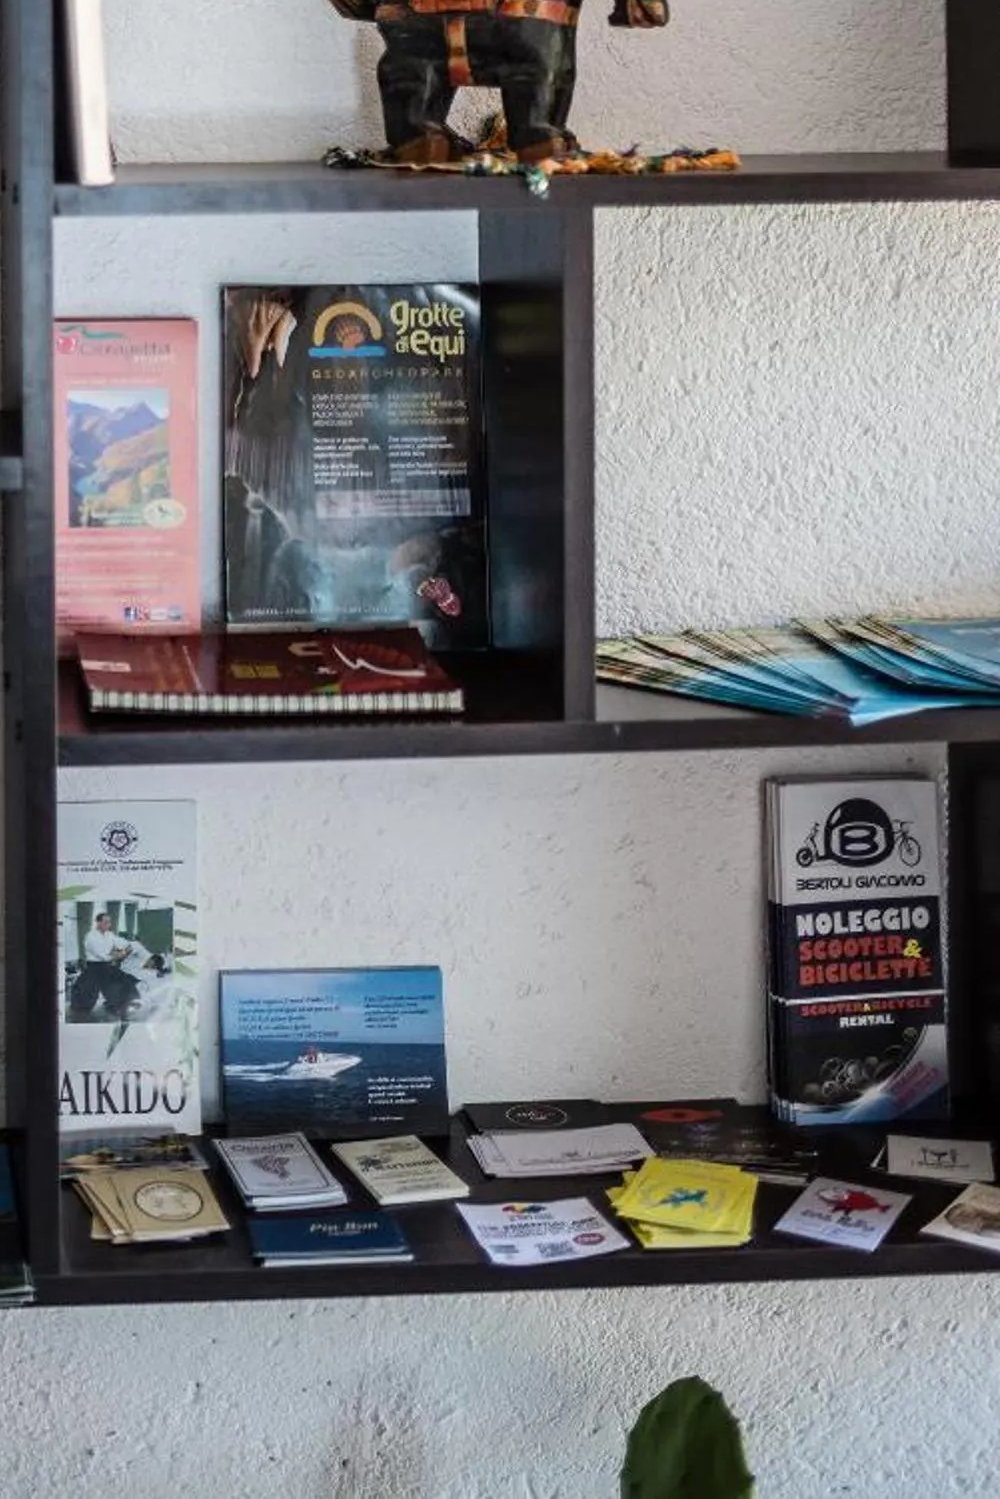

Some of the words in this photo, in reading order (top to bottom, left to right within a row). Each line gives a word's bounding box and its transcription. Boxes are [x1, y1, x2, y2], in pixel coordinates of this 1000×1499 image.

[390, 299, 465, 334] grotte
[855, 875, 926, 890] GIACOMO
[796, 905, 931, 938] NOLEGGIO
[798, 937, 902, 963] SCOOTER
[799, 956, 933, 987] BICICLETTE
[839, 1013, 895, 1028] RENTAL
[57, 1068, 187, 1116] AIKIDO
